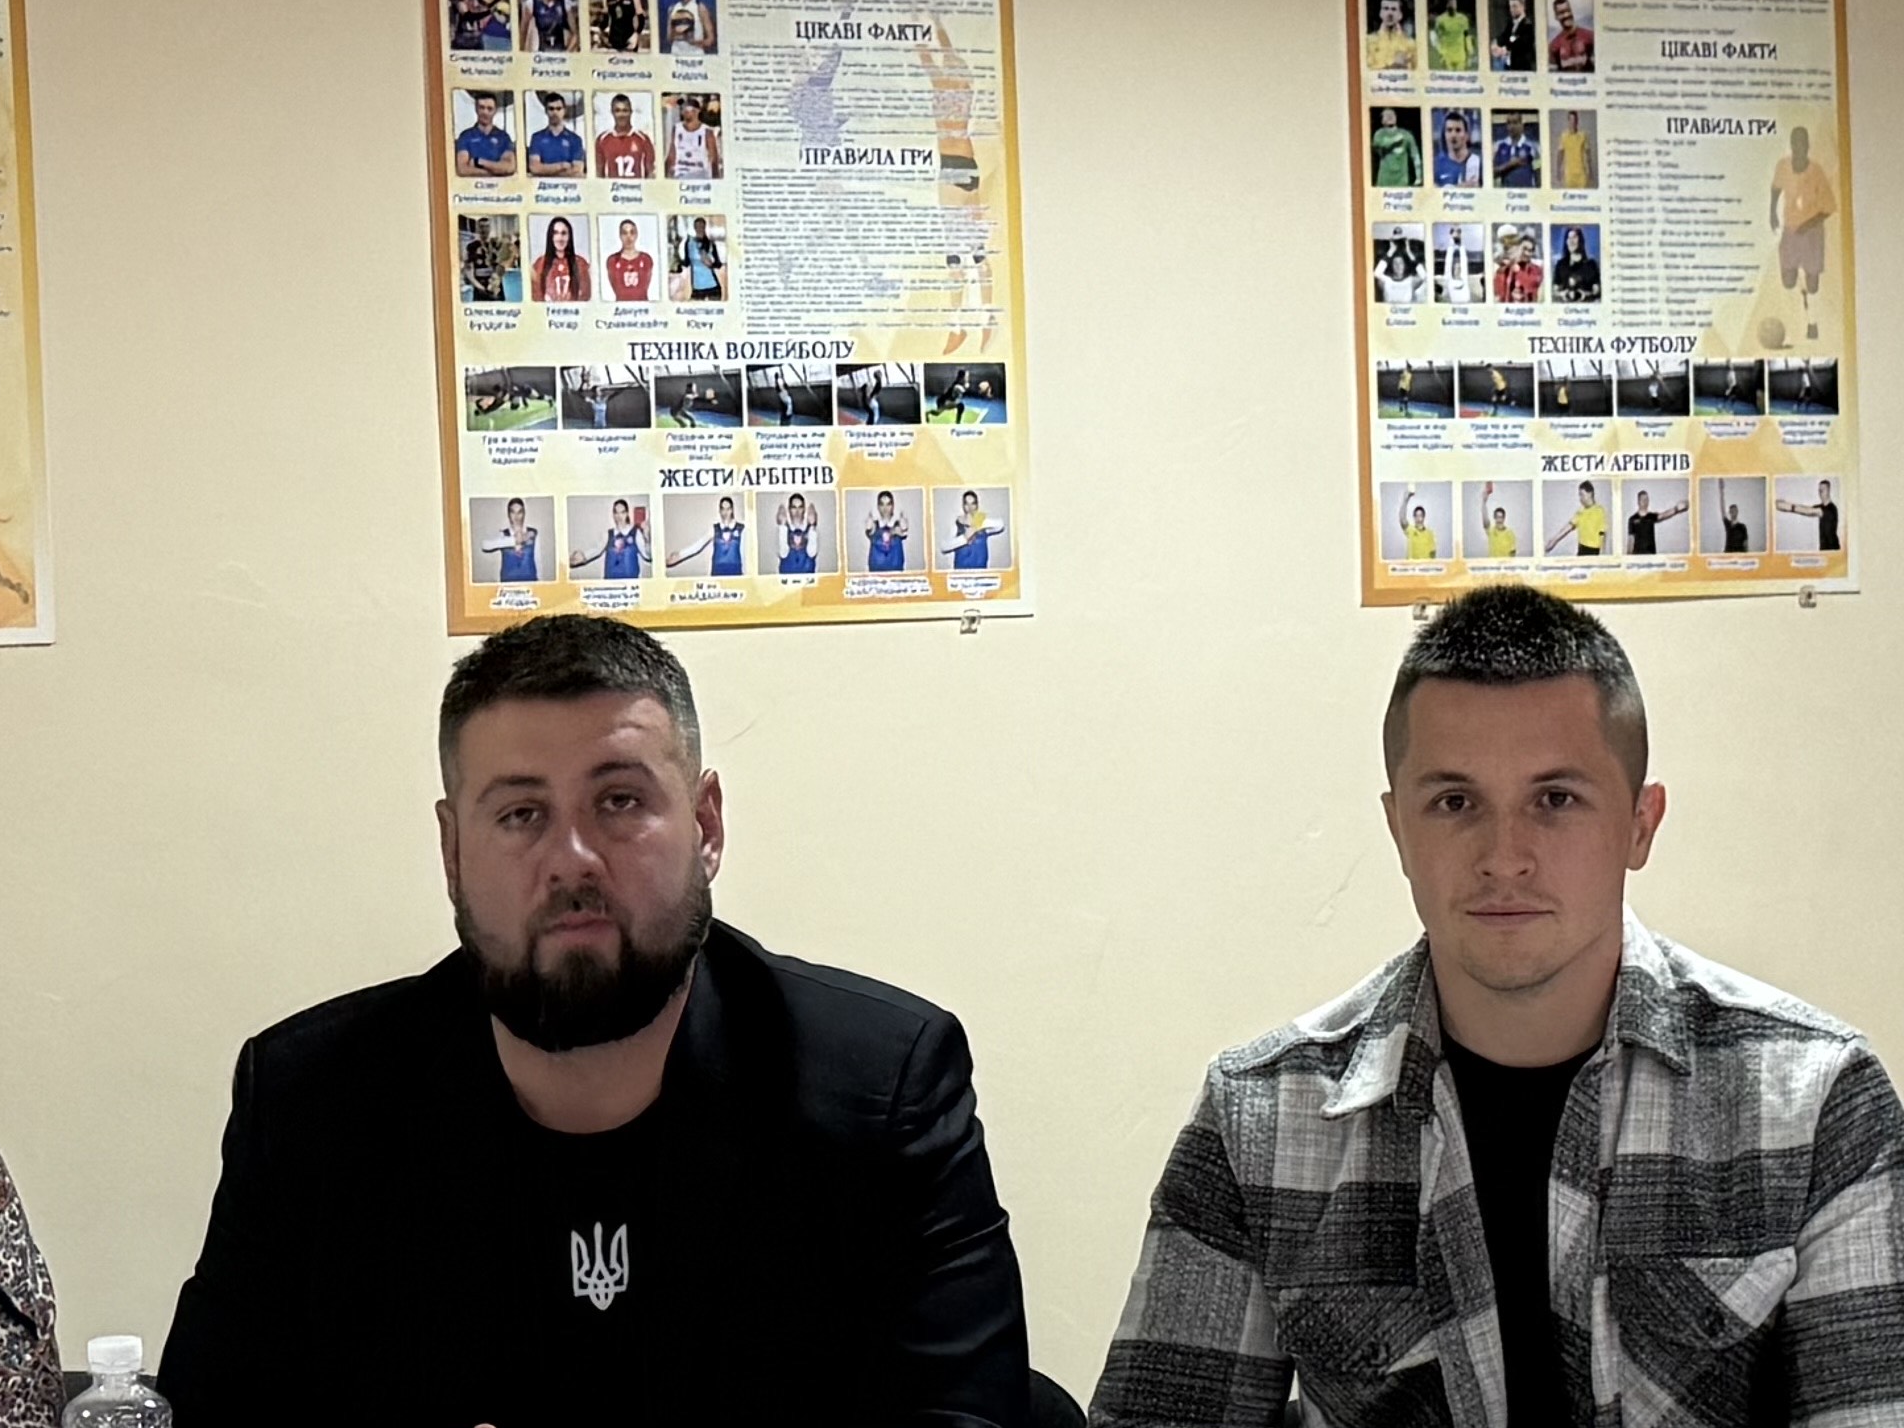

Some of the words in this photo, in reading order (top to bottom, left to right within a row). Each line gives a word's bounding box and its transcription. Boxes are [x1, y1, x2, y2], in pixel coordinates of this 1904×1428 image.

[796, 21, 863, 43] ЦІКАВІ
[868, 23, 933, 42] ФАКТИ
[1661, 40, 1718, 60] ЦІКАВІ
[1722, 41, 1778, 60] ФАКТИ
[1667, 117, 1745, 134] ПРАВИЛА
[1748, 119, 1777, 135] ГРИ
[805, 147, 895, 166] ПРАВИЛА
[900, 149, 933, 167] ГРИ
[627, 341, 720, 362] ТЕХНІКА
[727, 338, 856, 361] ВОЛЕЙБОЛУ
[1528, 335, 1606, 355] ТЕХНІКА
[1610, 334, 1697, 355] ФУТБОЛУ
[1541, 454, 1607, 473] ЖЕСТИ
[1609, 452, 1691, 473] АРБІТРІВ
[659, 468, 736, 489] ЖЕСТИ
[740, 465, 835, 488] АРБІТРІВ
